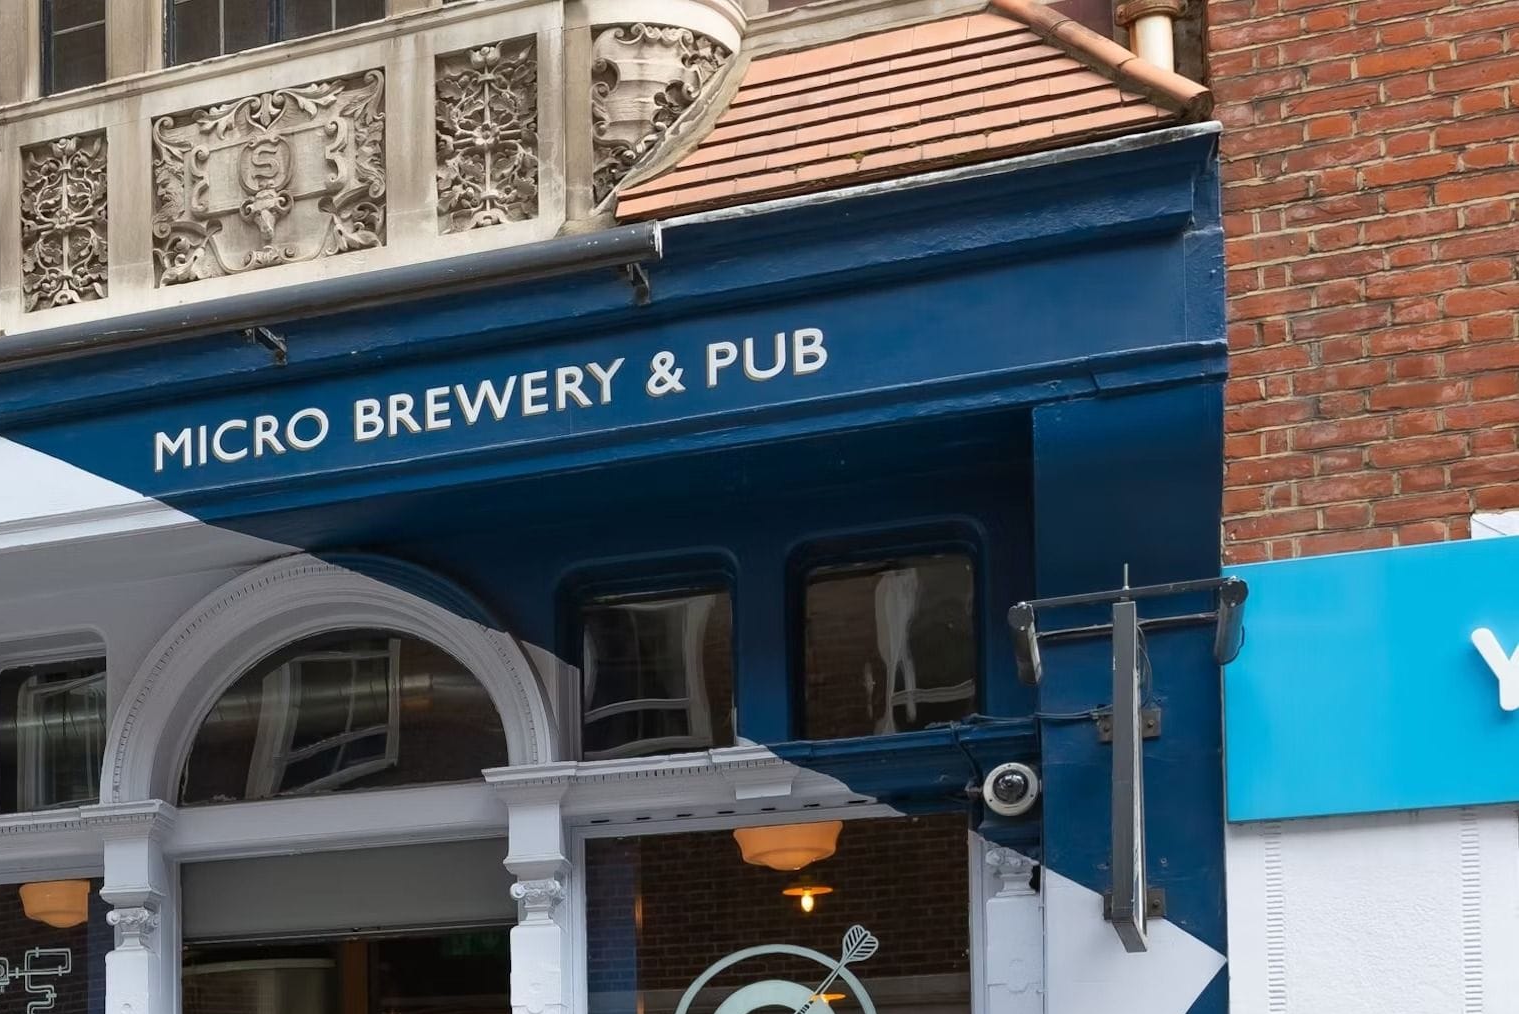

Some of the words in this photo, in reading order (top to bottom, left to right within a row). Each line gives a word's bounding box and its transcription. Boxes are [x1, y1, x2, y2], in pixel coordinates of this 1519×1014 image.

[154, 407, 329, 473] MICRO
[354, 357, 625, 443] BREWERY
[647, 350, 685, 398] &
[706, 328, 829, 389] PUB
